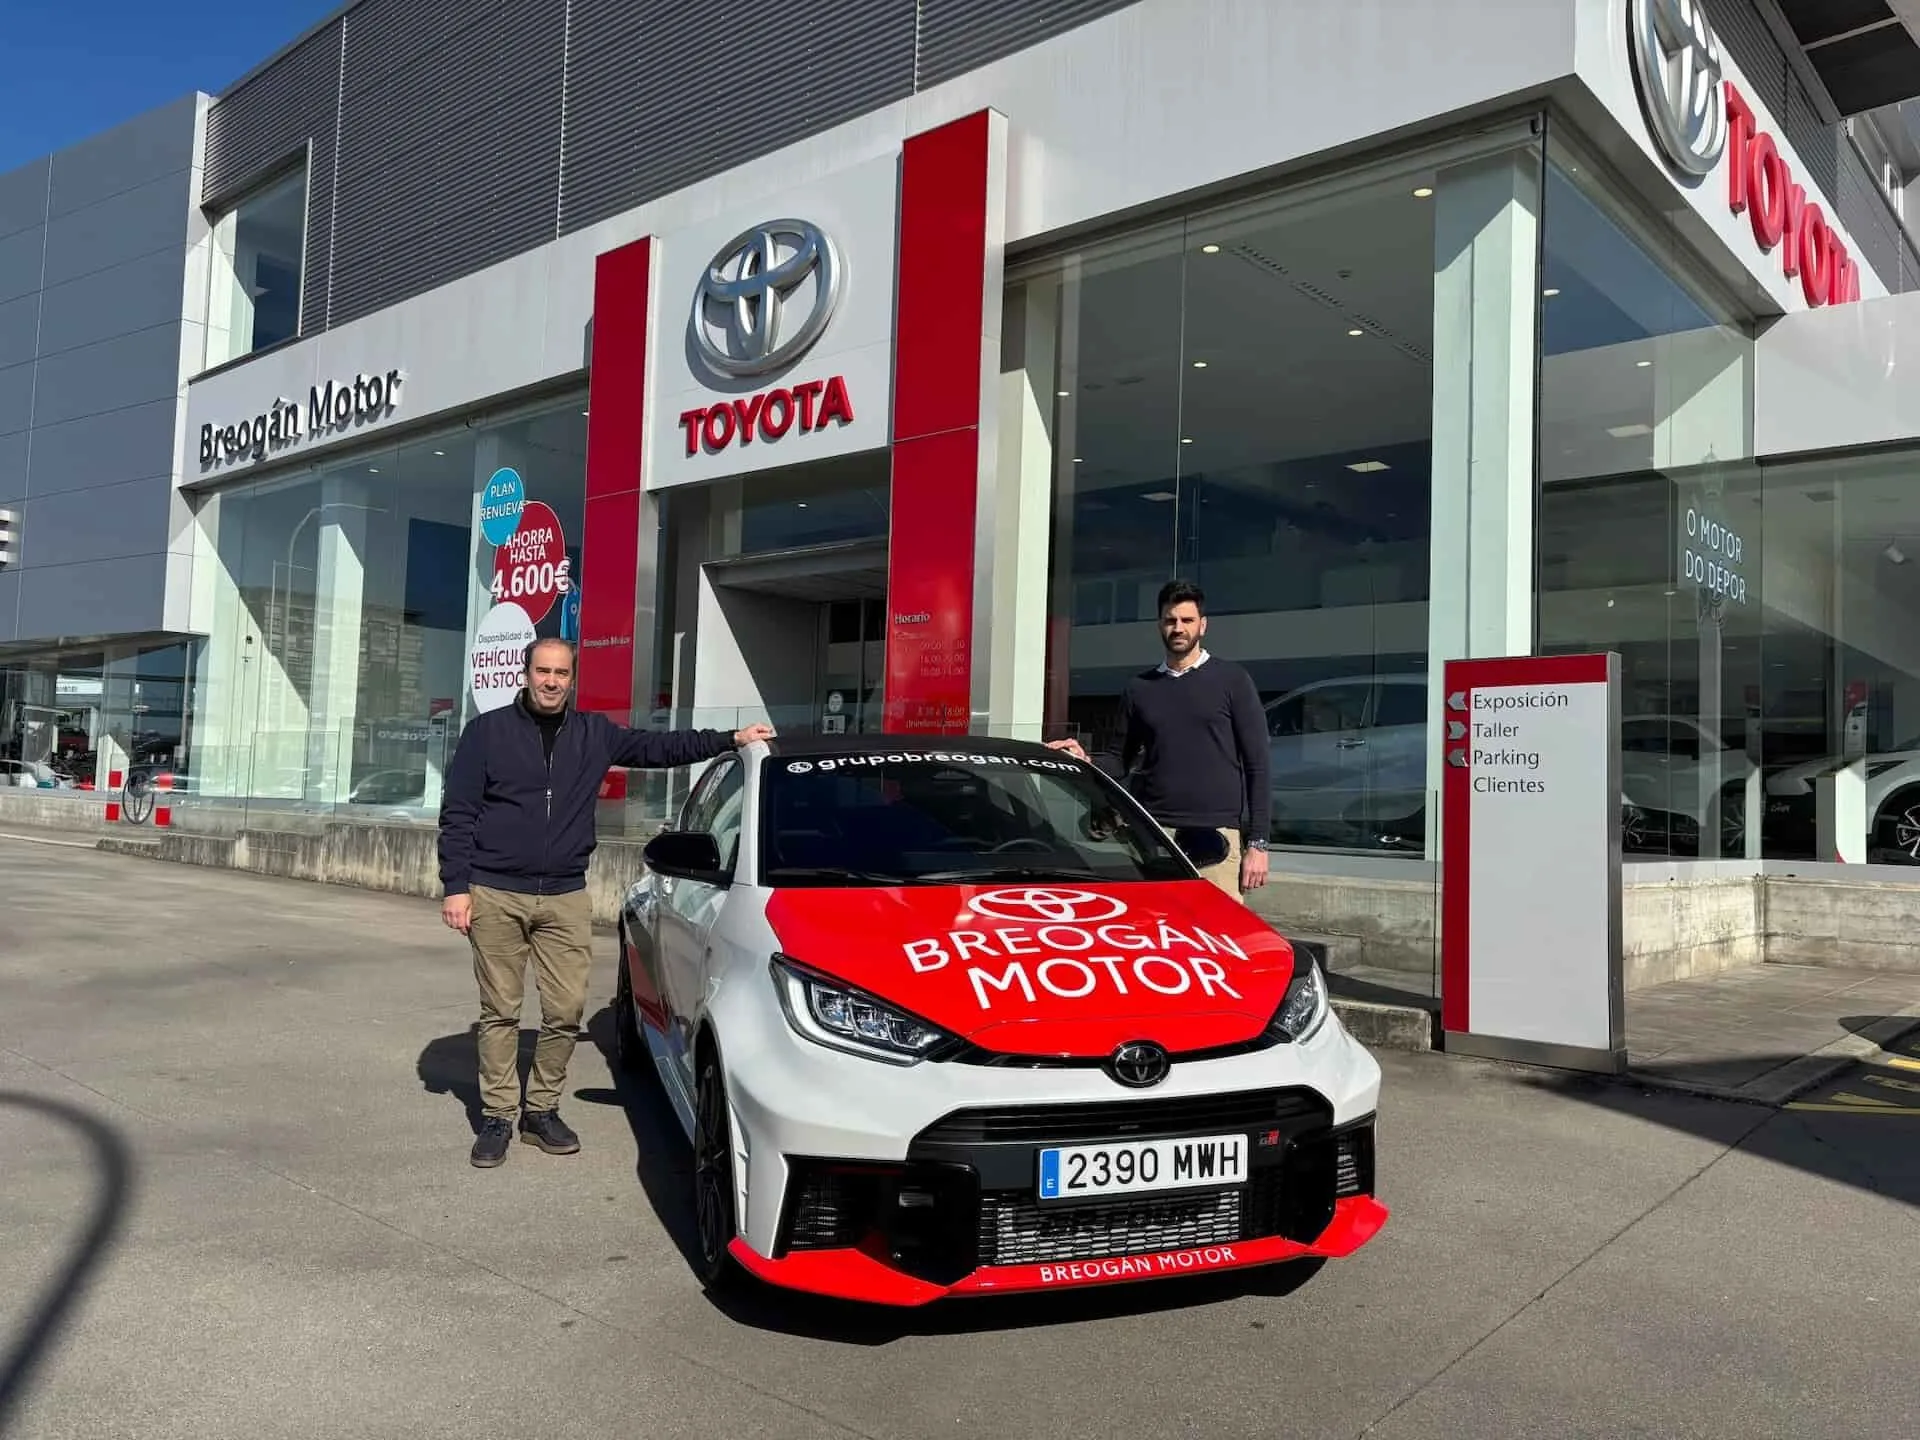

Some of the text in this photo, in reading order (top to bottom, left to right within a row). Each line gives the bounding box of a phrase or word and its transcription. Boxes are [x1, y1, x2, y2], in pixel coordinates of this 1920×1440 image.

[1723, 80, 1860, 308] TOYOTA
[199, 370, 402, 461] Breogán Motor
[680, 376, 854, 454] TOYOTA
[490, 480, 516, 497] PLAN
[480, 501, 524, 521] RENUEVA
[504, 528, 554, 550] AHORRA
[1686, 508, 1742, 564] O MOTOR
[510, 545, 546, 564] HASTA
[1685, 549, 1704, 583] DO
[490, 558, 571, 600] 4.600€
[478, 630, 533, 645] Disponibilidad de
[472, 647, 528, 668] VEHÍCULO
[474, 671, 528, 689] EN STOC
[1473, 691, 1568, 713] Exposición
[1473, 722, 1519, 738] Taller
[817, 751, 1082, 774] grupobreogan.com
[1473, 749, 1539, 769] Parking
[1473, 776, 1545, 793] Clientes
[902, 918, 1250, 973] BREOGÁN
[967, 955, 1243, 1009] MOTOR
[1066, 1149, 1159, 1190] 2390
[1173, 1141, 1239, 1181] MWH
[1040, 1246, 1236, 1283] BREOGÁN MOTOR
